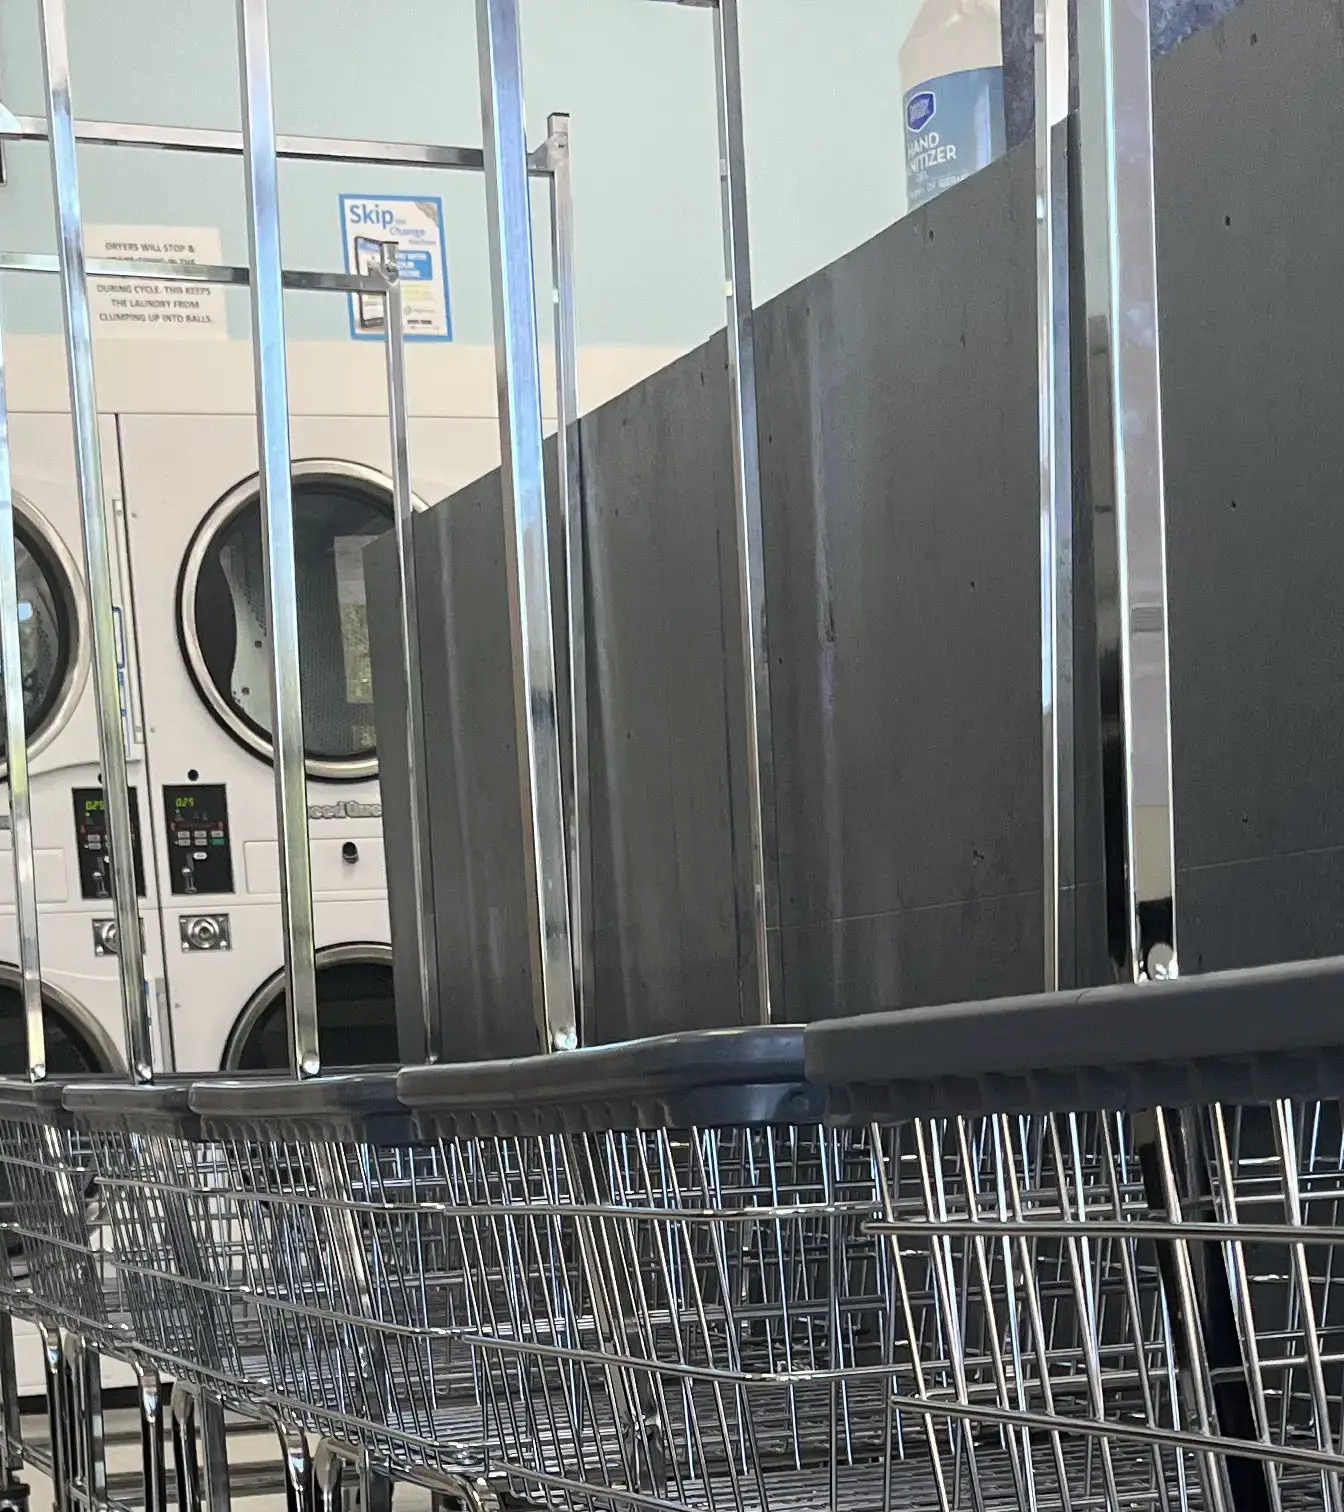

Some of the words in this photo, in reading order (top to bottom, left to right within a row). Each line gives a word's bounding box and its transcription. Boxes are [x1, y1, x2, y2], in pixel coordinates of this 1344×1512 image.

[350, 203, 394, 230] Skip
[141, 243, 162, 252] WILL
[164, 243, 186, 252] STOP
[97, 284, 132, 293] DURING
[186, 287, 211, 295] KEEPS
[111, 299, 128, 308] THE
[130, 299, 171, 308] LAUNDRY
[173, 300, 200, 309] FROM
[99, 313, 146, 322] CLUMPING
[148, 313, 160, 322] UP
[162, 314, 184, 322] INTO
